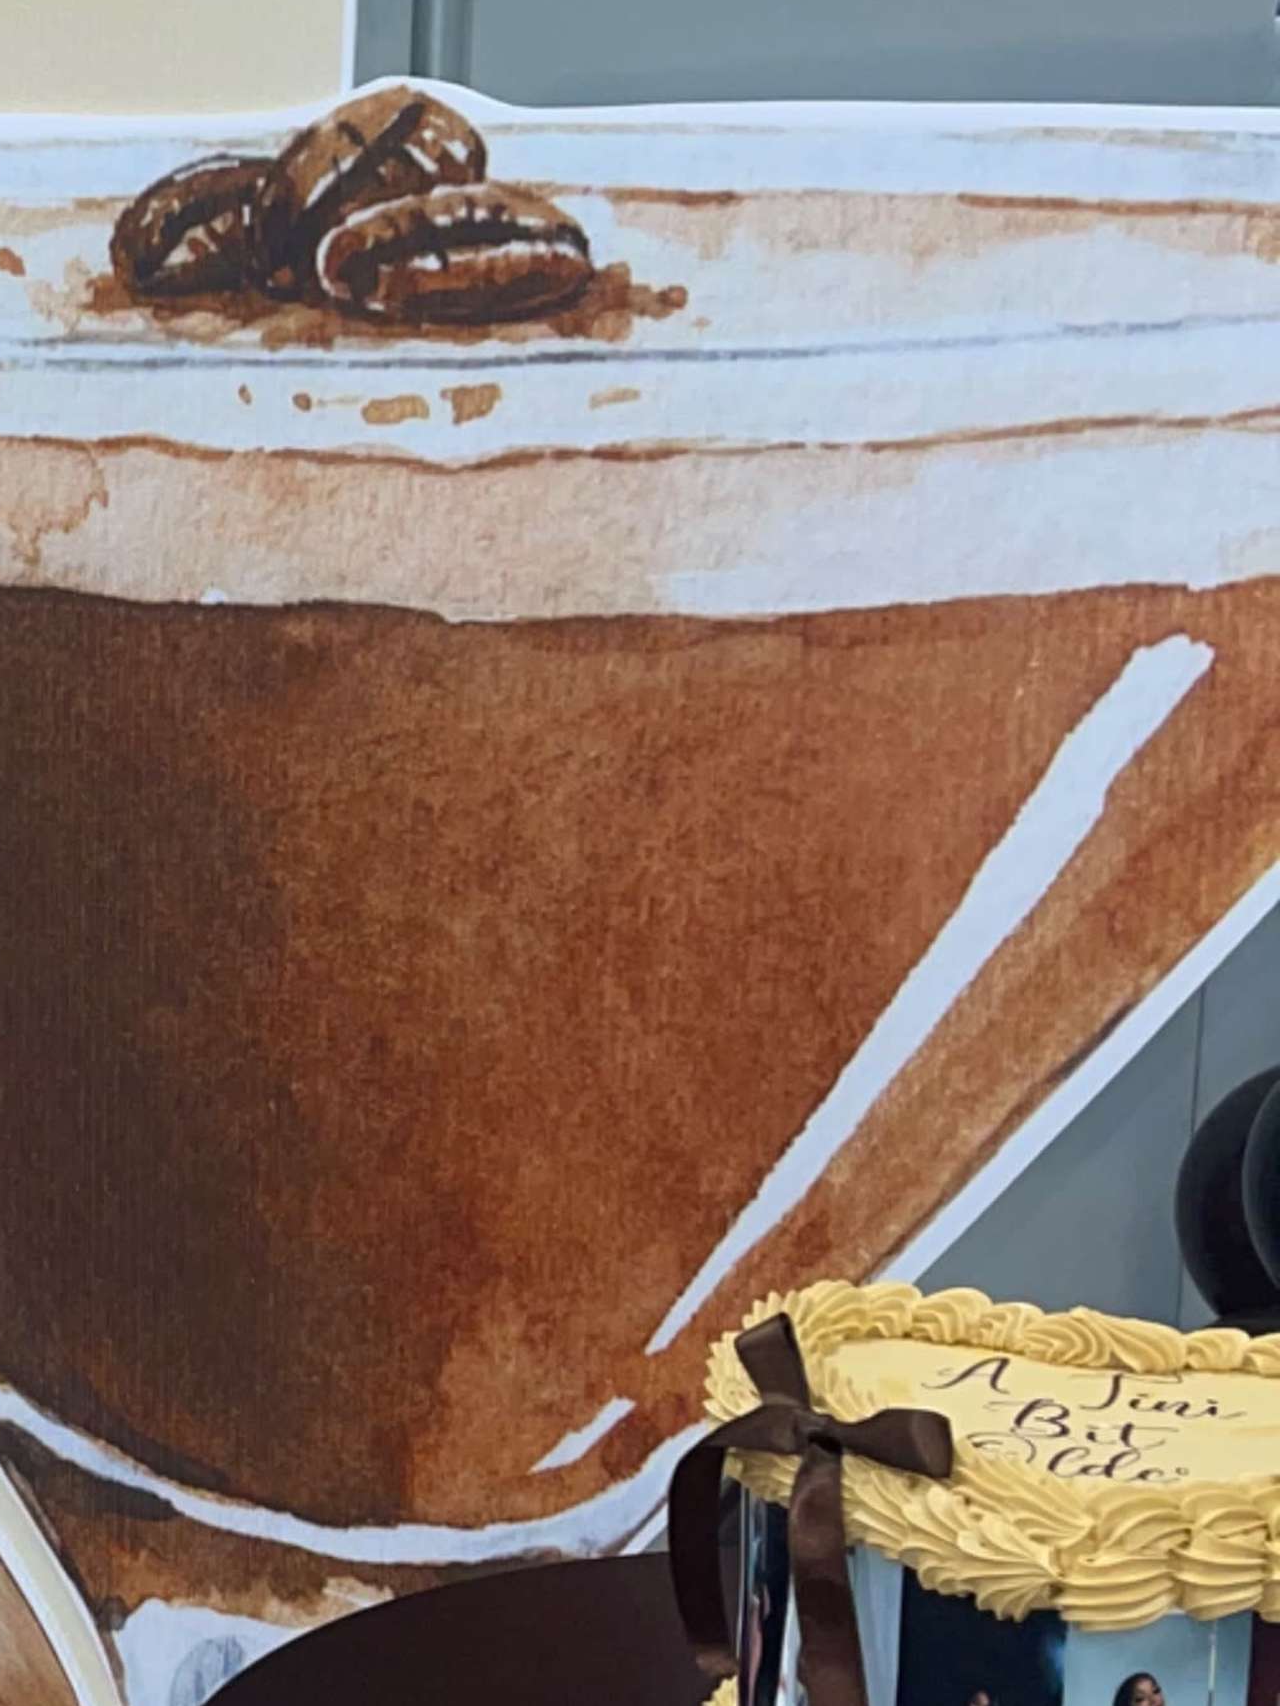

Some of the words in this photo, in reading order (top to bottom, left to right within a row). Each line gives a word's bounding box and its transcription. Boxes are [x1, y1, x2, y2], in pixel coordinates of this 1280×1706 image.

[922, 1356, 1011, 1394] A
[1068, 1373, 1247, 1420] Tini
[986, 1398, 1180, 1449] Bit
